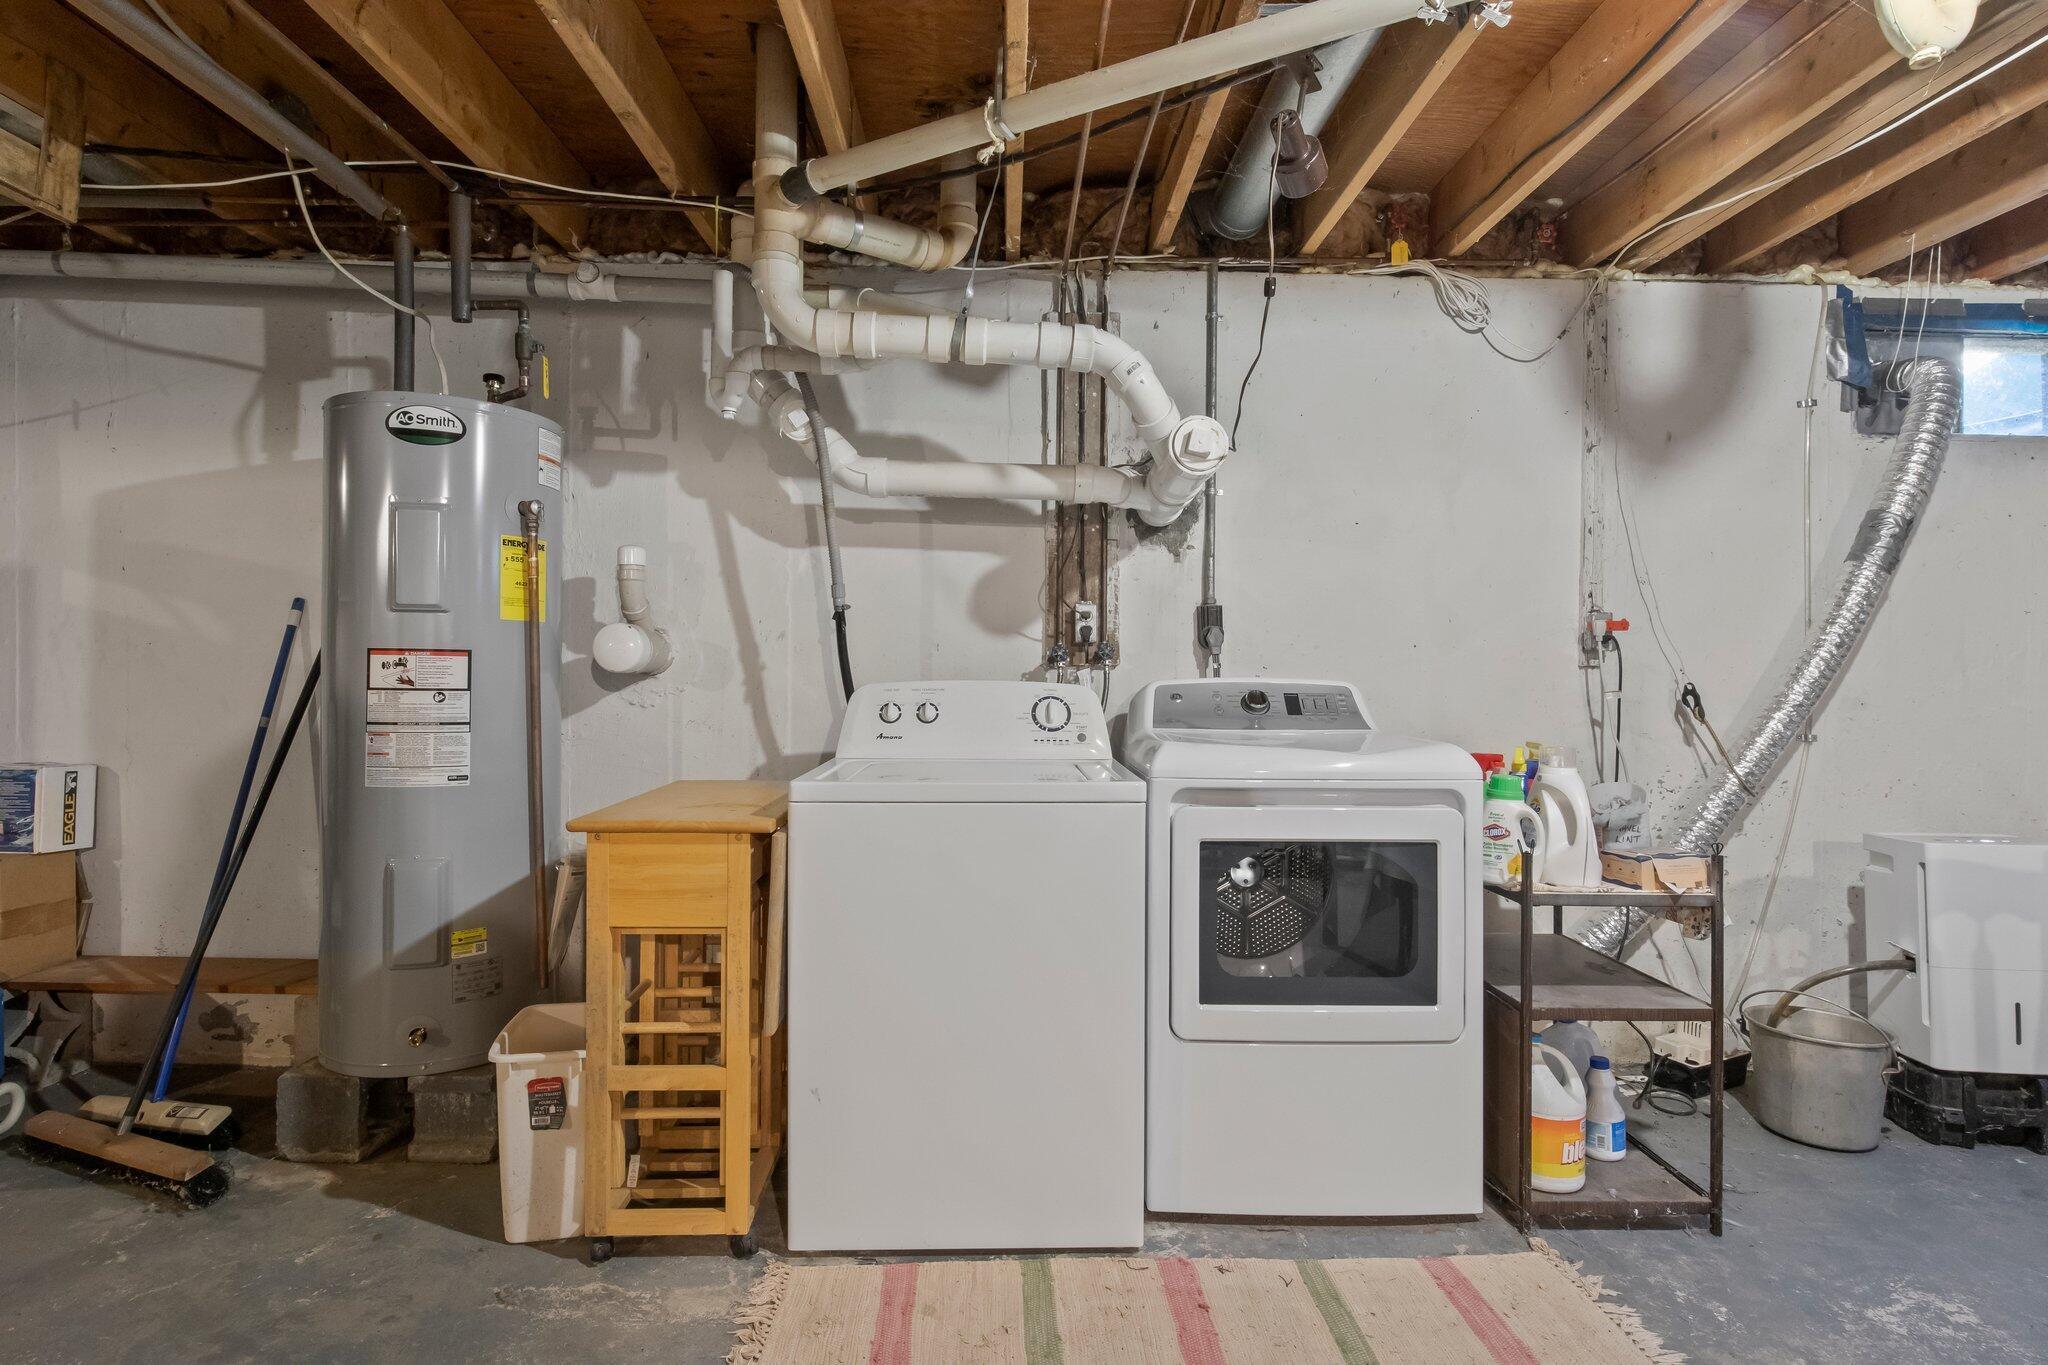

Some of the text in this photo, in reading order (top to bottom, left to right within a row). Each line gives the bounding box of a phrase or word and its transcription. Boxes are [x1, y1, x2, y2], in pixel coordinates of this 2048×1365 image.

[876, 732, 903, 740] Amana
[63, 793, 76, 844] EAGLE
[1615, 835, 1641, 843] LINT
